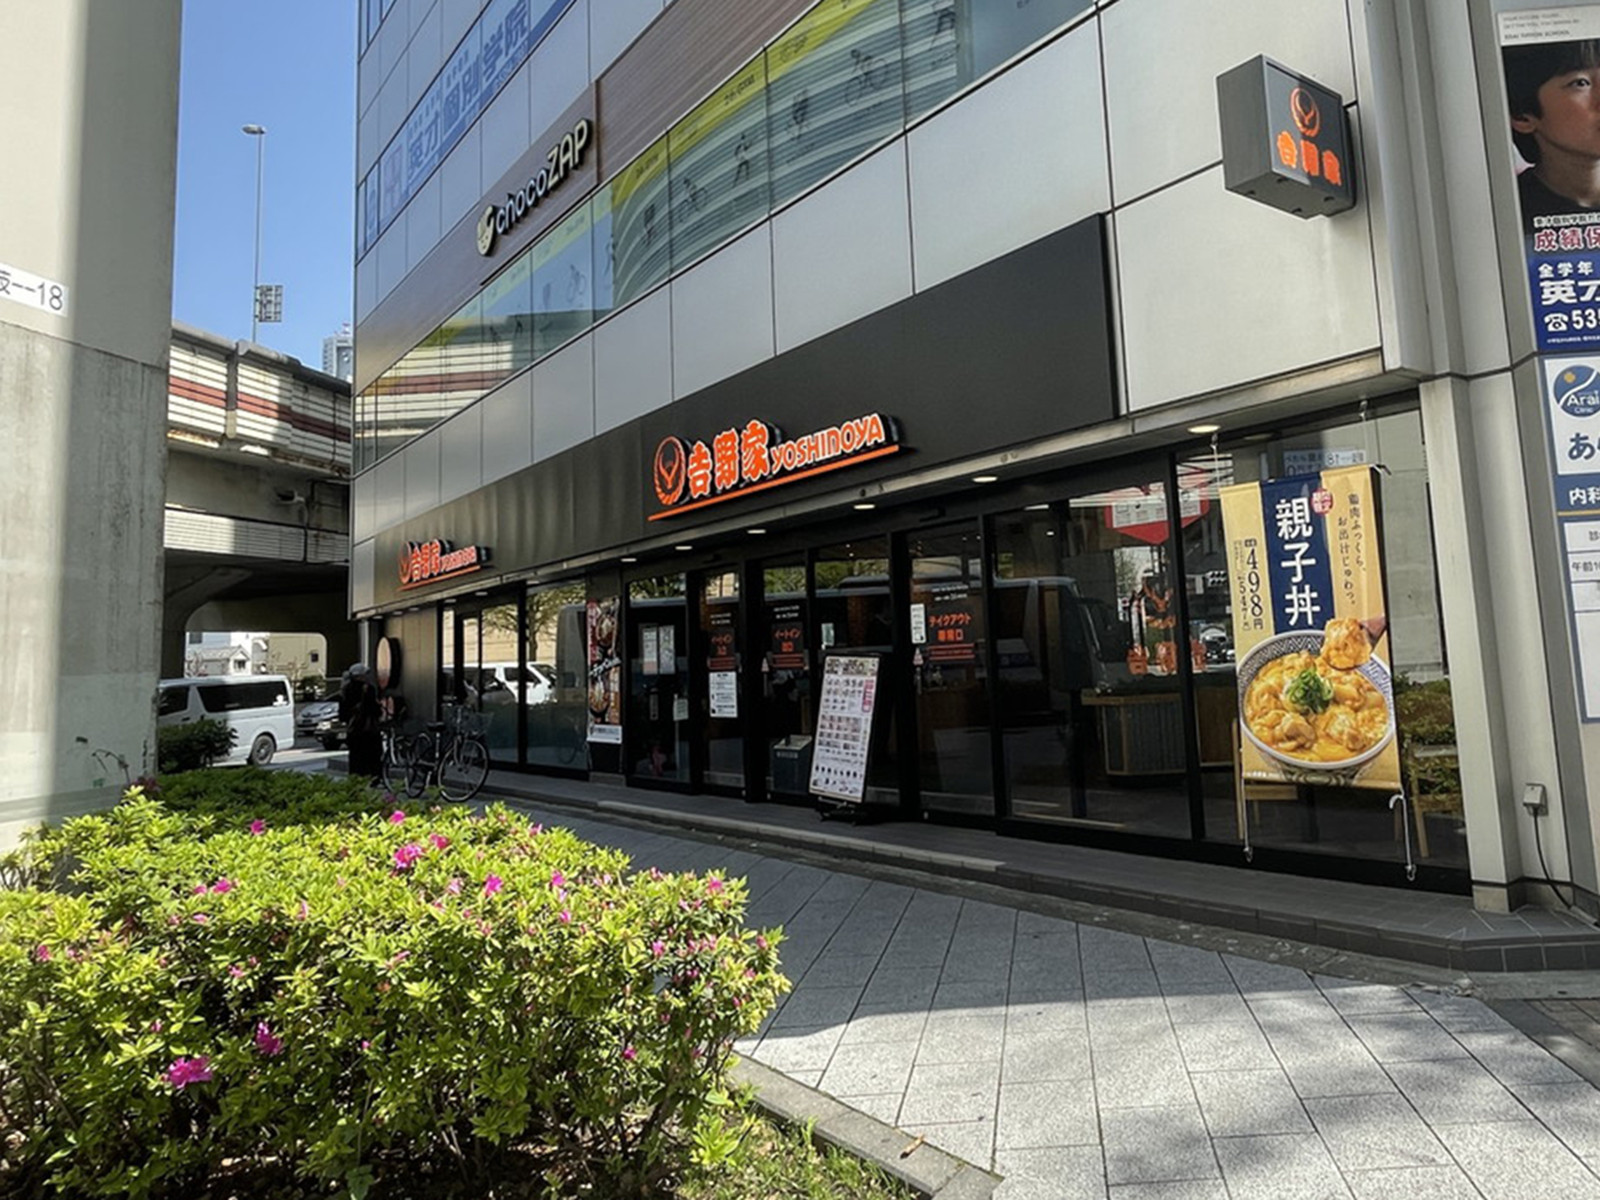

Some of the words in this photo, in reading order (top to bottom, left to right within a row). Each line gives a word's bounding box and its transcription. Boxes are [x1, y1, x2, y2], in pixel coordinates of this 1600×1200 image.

[1538, 261, 1593, 278] 全学年
[1572, 308, 1600, 330] 53
[1568, 432, 1600, 460] あ
[1275, 496, 1321, 627] 親子丼
